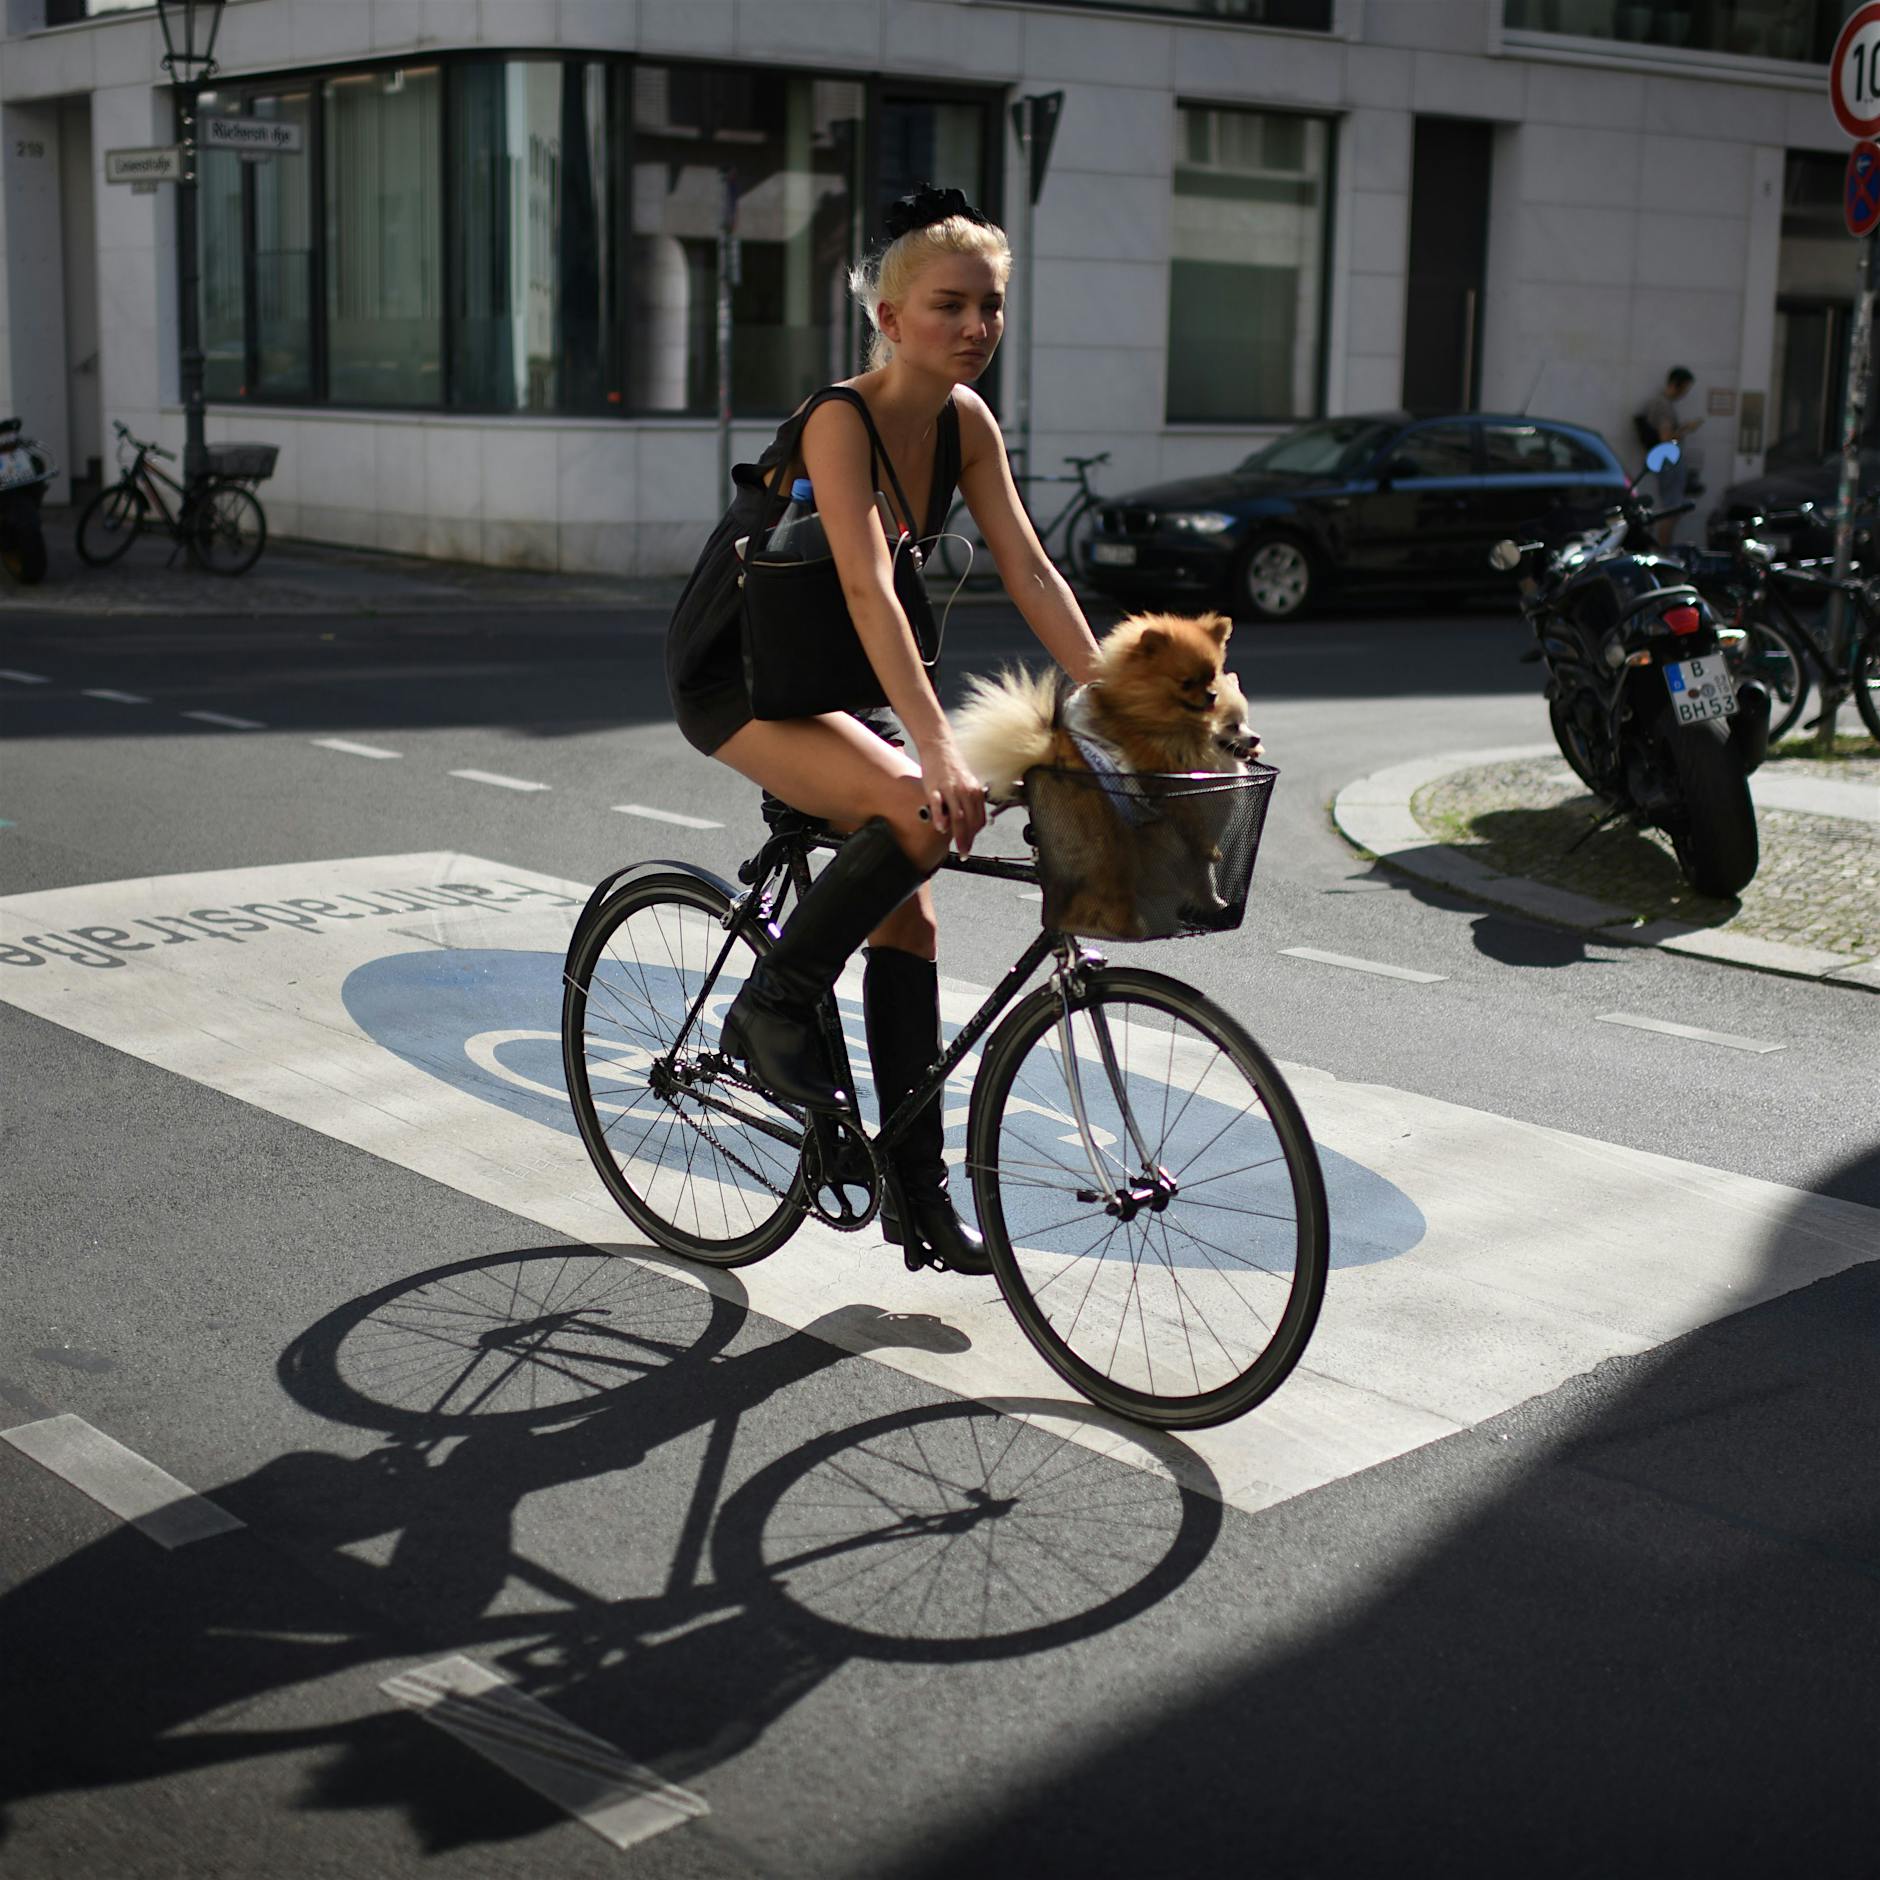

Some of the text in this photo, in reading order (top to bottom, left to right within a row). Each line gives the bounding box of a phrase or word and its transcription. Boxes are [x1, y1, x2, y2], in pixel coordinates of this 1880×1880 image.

[1691, 661, 1704, 677] B
[1680, 695, 1734, 721] BH 53
[0, 880, 585, 968] Fahrradstraße
